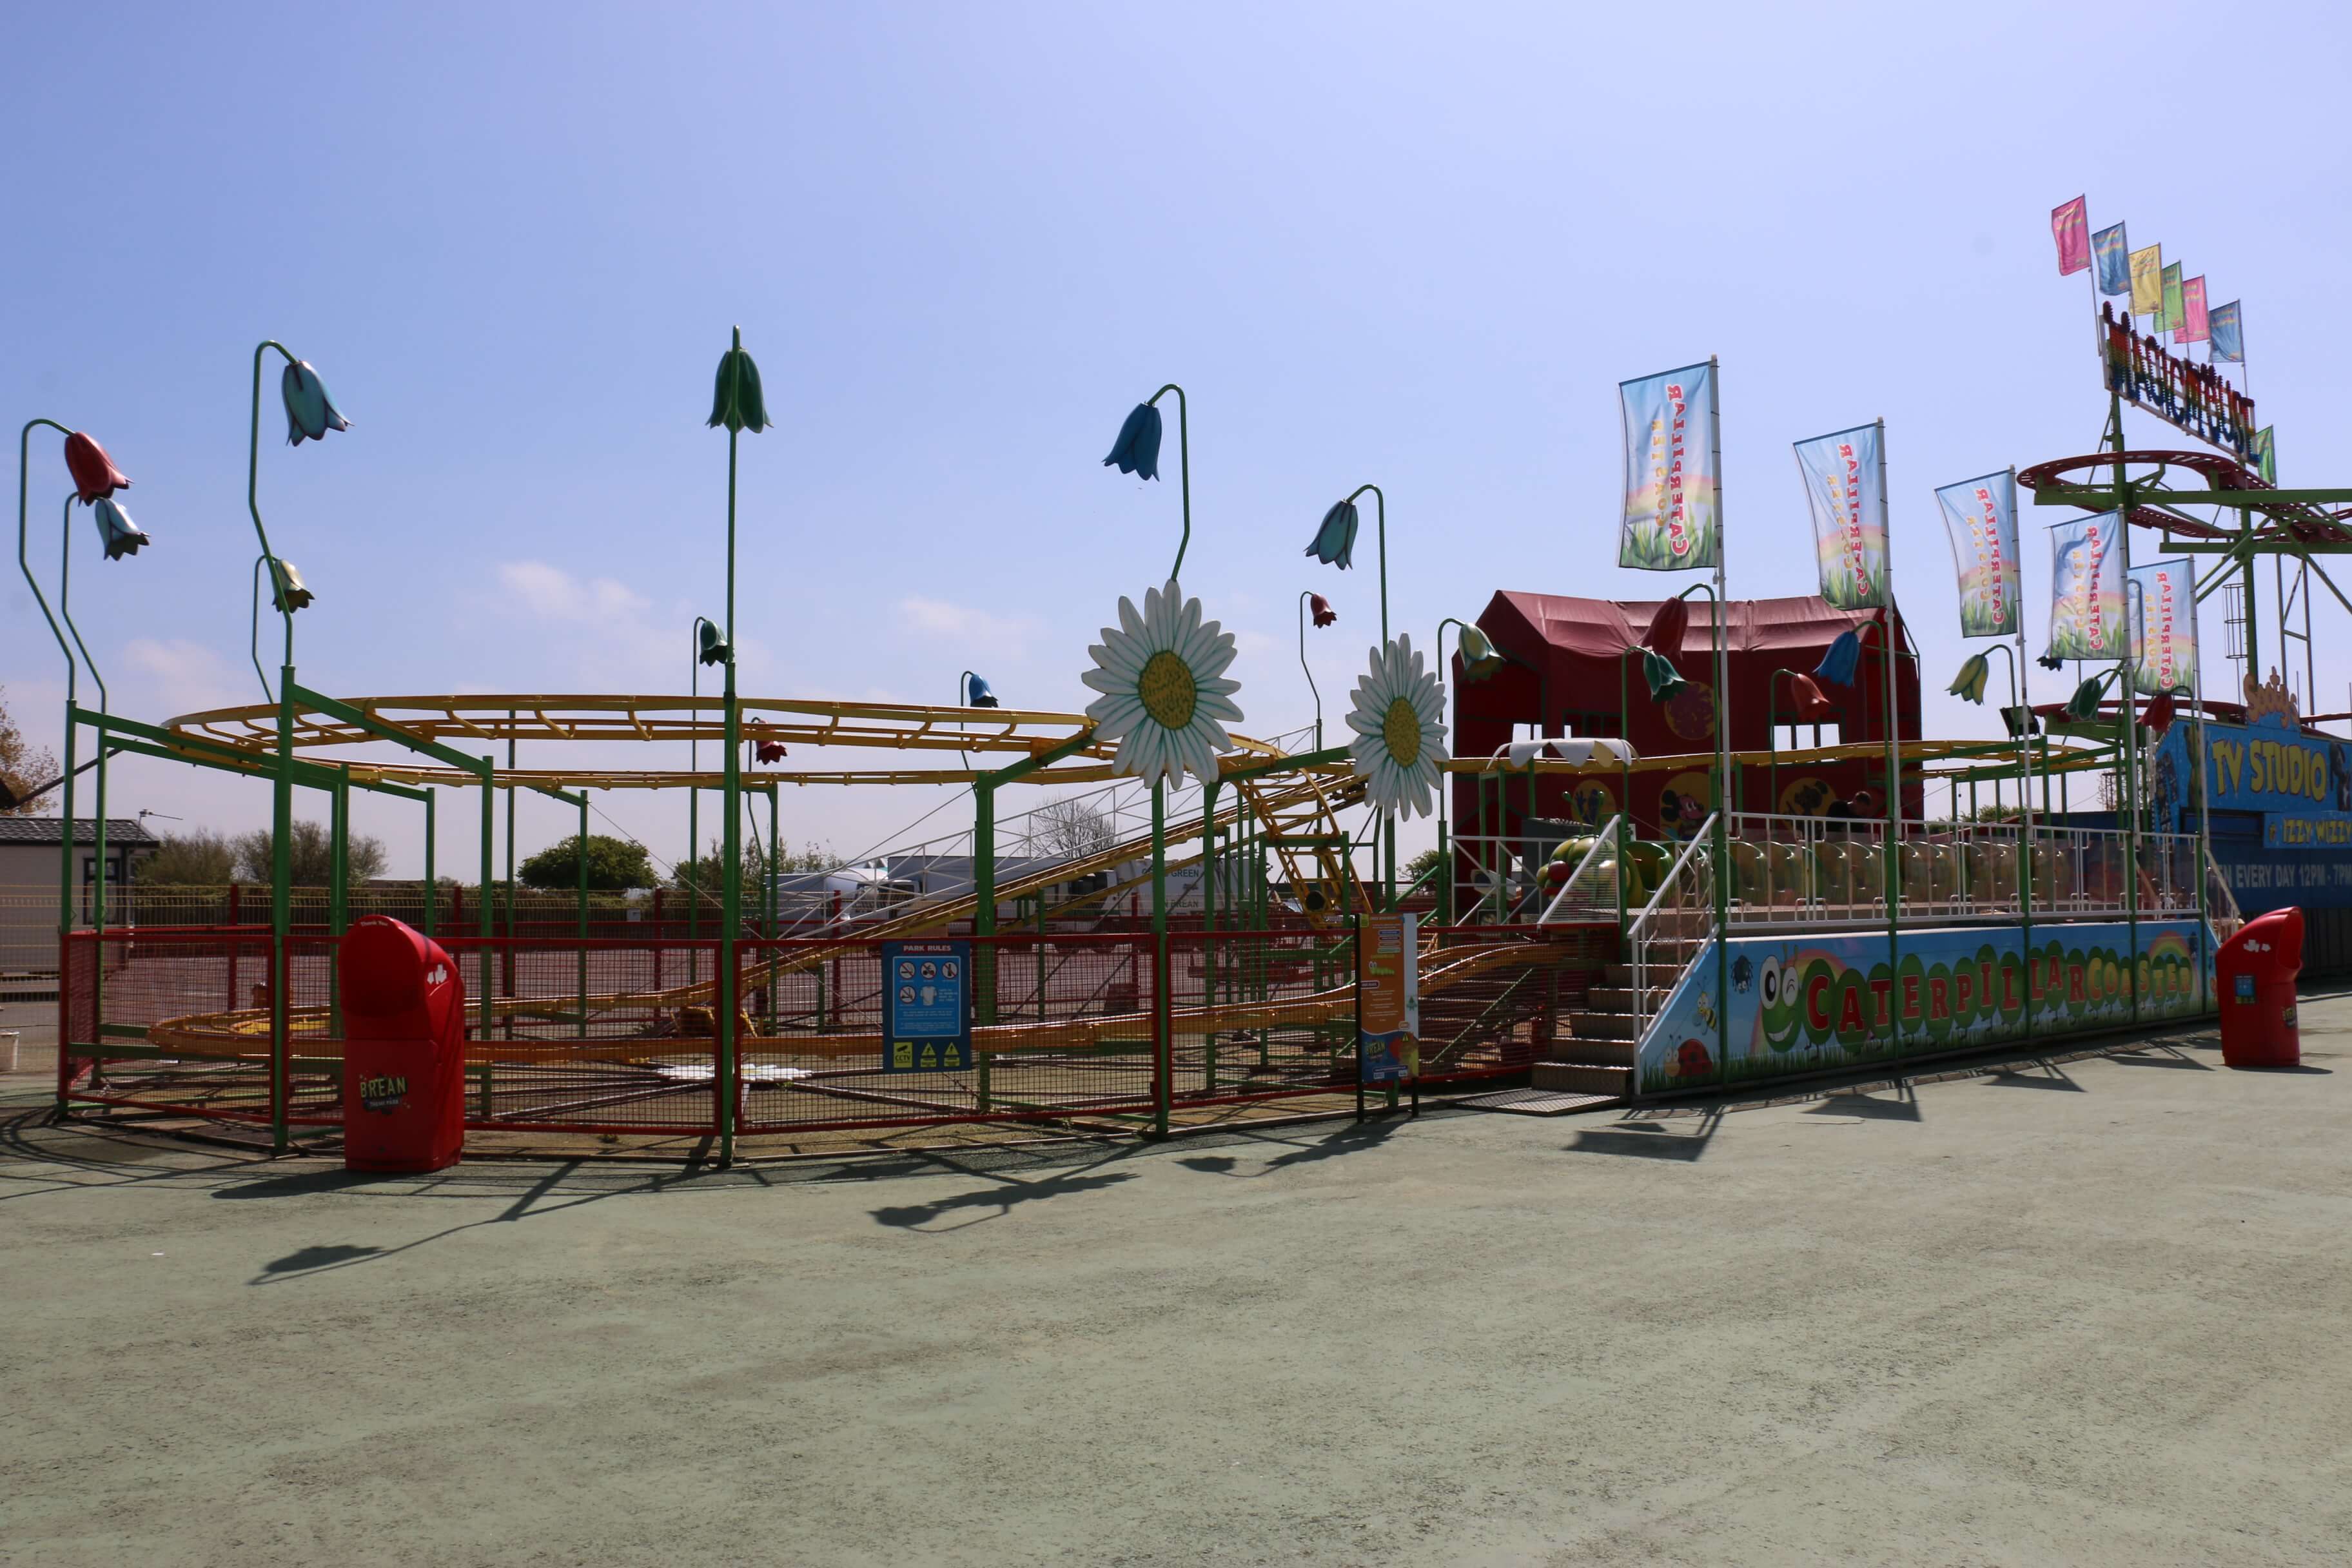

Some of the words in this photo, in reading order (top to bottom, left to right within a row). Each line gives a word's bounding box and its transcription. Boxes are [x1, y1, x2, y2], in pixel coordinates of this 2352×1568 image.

[2212, 738, 2244, 796] TV
[2249, 738, 2328, 803] STUDIO
[2283, 819, 2311, 844] IZZY
[2315, 819, 2352, 844] WIZZY
[1171, 868, 1199, 877] GREEN
[2236, 865, 2272, 888] EVERY
[2275, 865, 2296, 888] DAY
[2299, 865, 2325, 887] 12PM
[1807, 955, 2086, 1033] CATERPILLAR
[2087, 957, 2191, 1001] COASTER
[360, 1077, 407, 1098] BREAN
